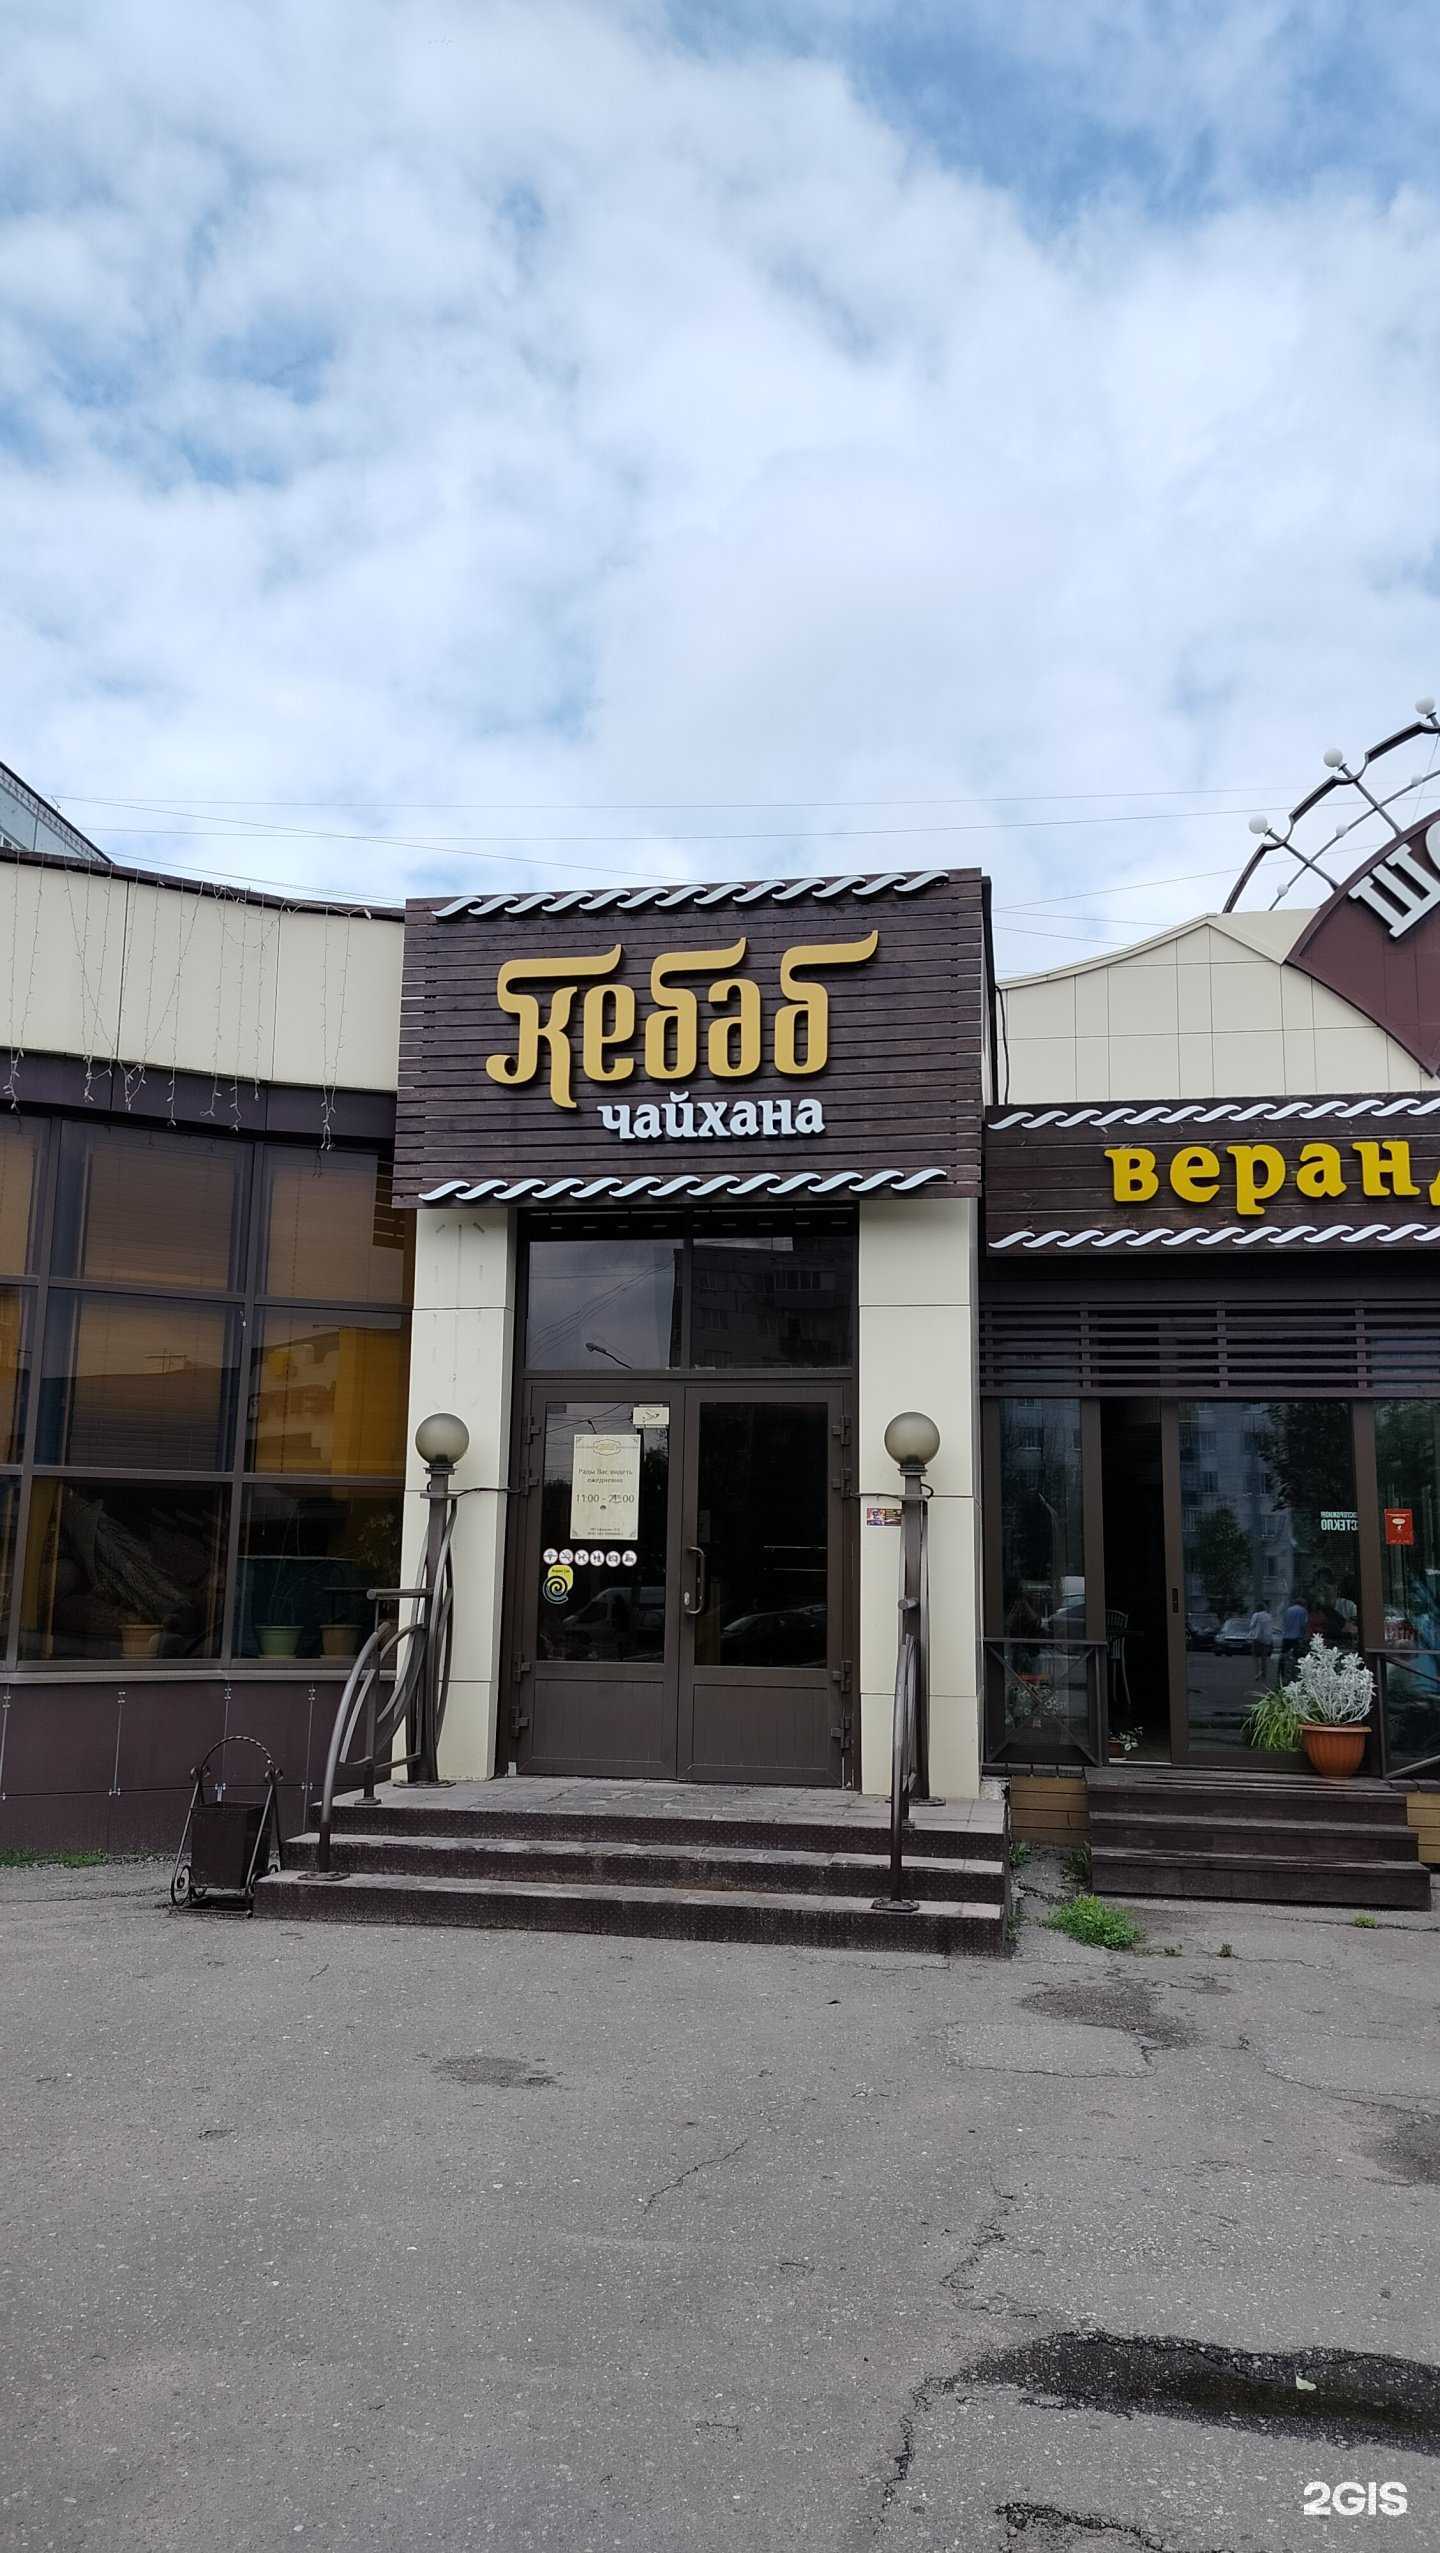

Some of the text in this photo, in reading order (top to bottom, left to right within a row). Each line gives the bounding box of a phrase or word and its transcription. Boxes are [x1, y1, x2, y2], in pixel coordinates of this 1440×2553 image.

[1348, 820, 1440, 938] Ш
[597, 1091, 826, 1140] чайхана
[1104, 1140, 1440, 1216] веран
